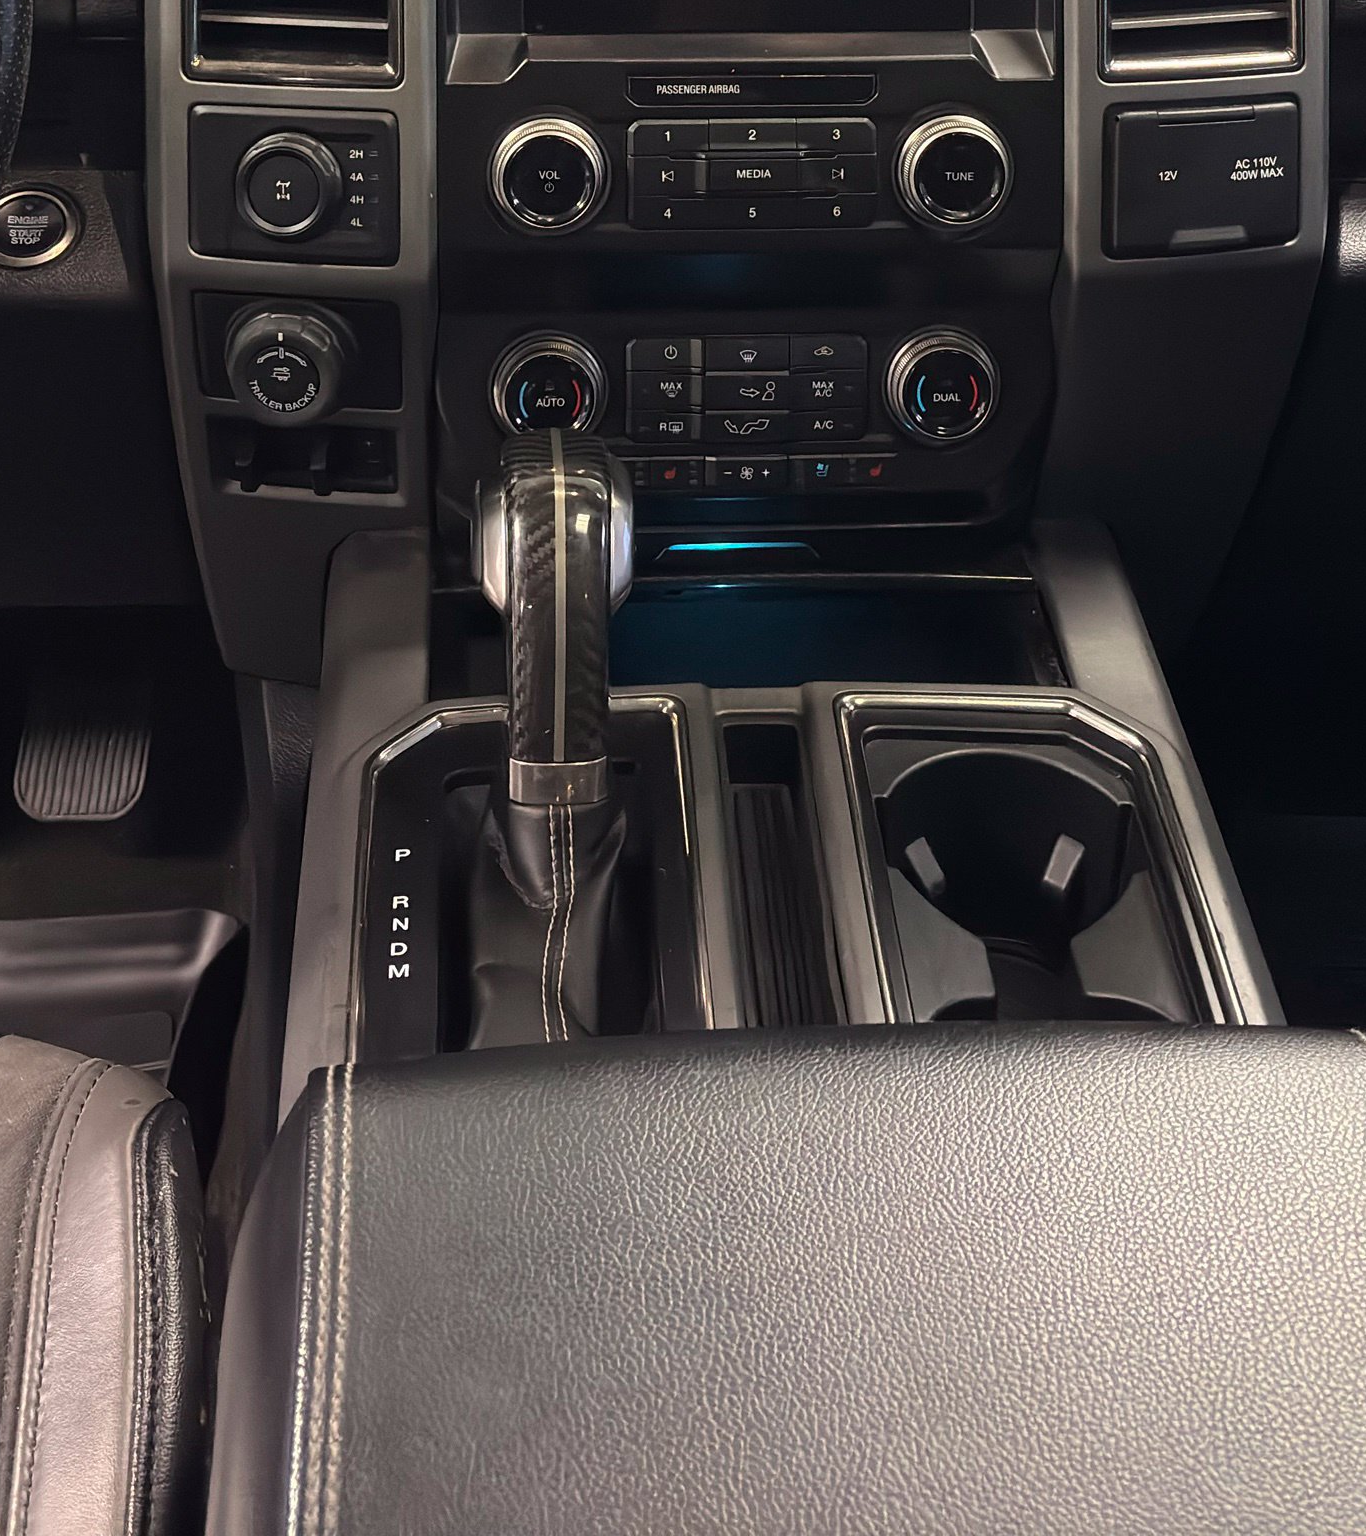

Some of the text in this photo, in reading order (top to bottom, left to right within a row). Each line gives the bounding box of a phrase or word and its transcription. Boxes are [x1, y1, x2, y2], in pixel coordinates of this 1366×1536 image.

[656, 84, 741, 95] PASSENGER AIRBAG
[664, 130, 670, 142] 1
[748, 129, 757, 141] 2
[832, 128, 841, 140] 3
[349, 149, 364, 159] 2H
[1234, 156, 1278, 170] AC 110V
[349, 172, 364, 182] 4A
[538, 170, 561, 180] VOL
[736, 168, 772, 179] MEDIA
[944, 171, 975, 181] TUNE
[1158, 170, 1178, 181] 12V
[1230, 165, 1284, 181] 400W MAX
[349, 195, 364, 205] 4H
[663, 207, 672, 219] 4
[748, 207, 757, 218] 5
[832, 205, 841, 217] 6
[7, 215, 49, 225] ENGINE
[350, 217, 364, 227] 4L
[8, 228, 44, 239] START
[10, 235, 41, 245] STOP
[660, 381, 683, 392] MAX
[812, 380, 834, 391] MAX
[249, 379, 317, 411] TRAILER BACKUP
[814, 387, 834, 398] A/C
[933, 392, 961, 403] DUAL
[535, 397, 566, 408] AUTO
[813, 420, 834, 430] A/C
[394, 848, 411, 862] P
[392, 895, 409, 910] R
[392, 917, 409, 932] N
[390, 942, 408, 957] D
[388, 963, 410, 979] M
